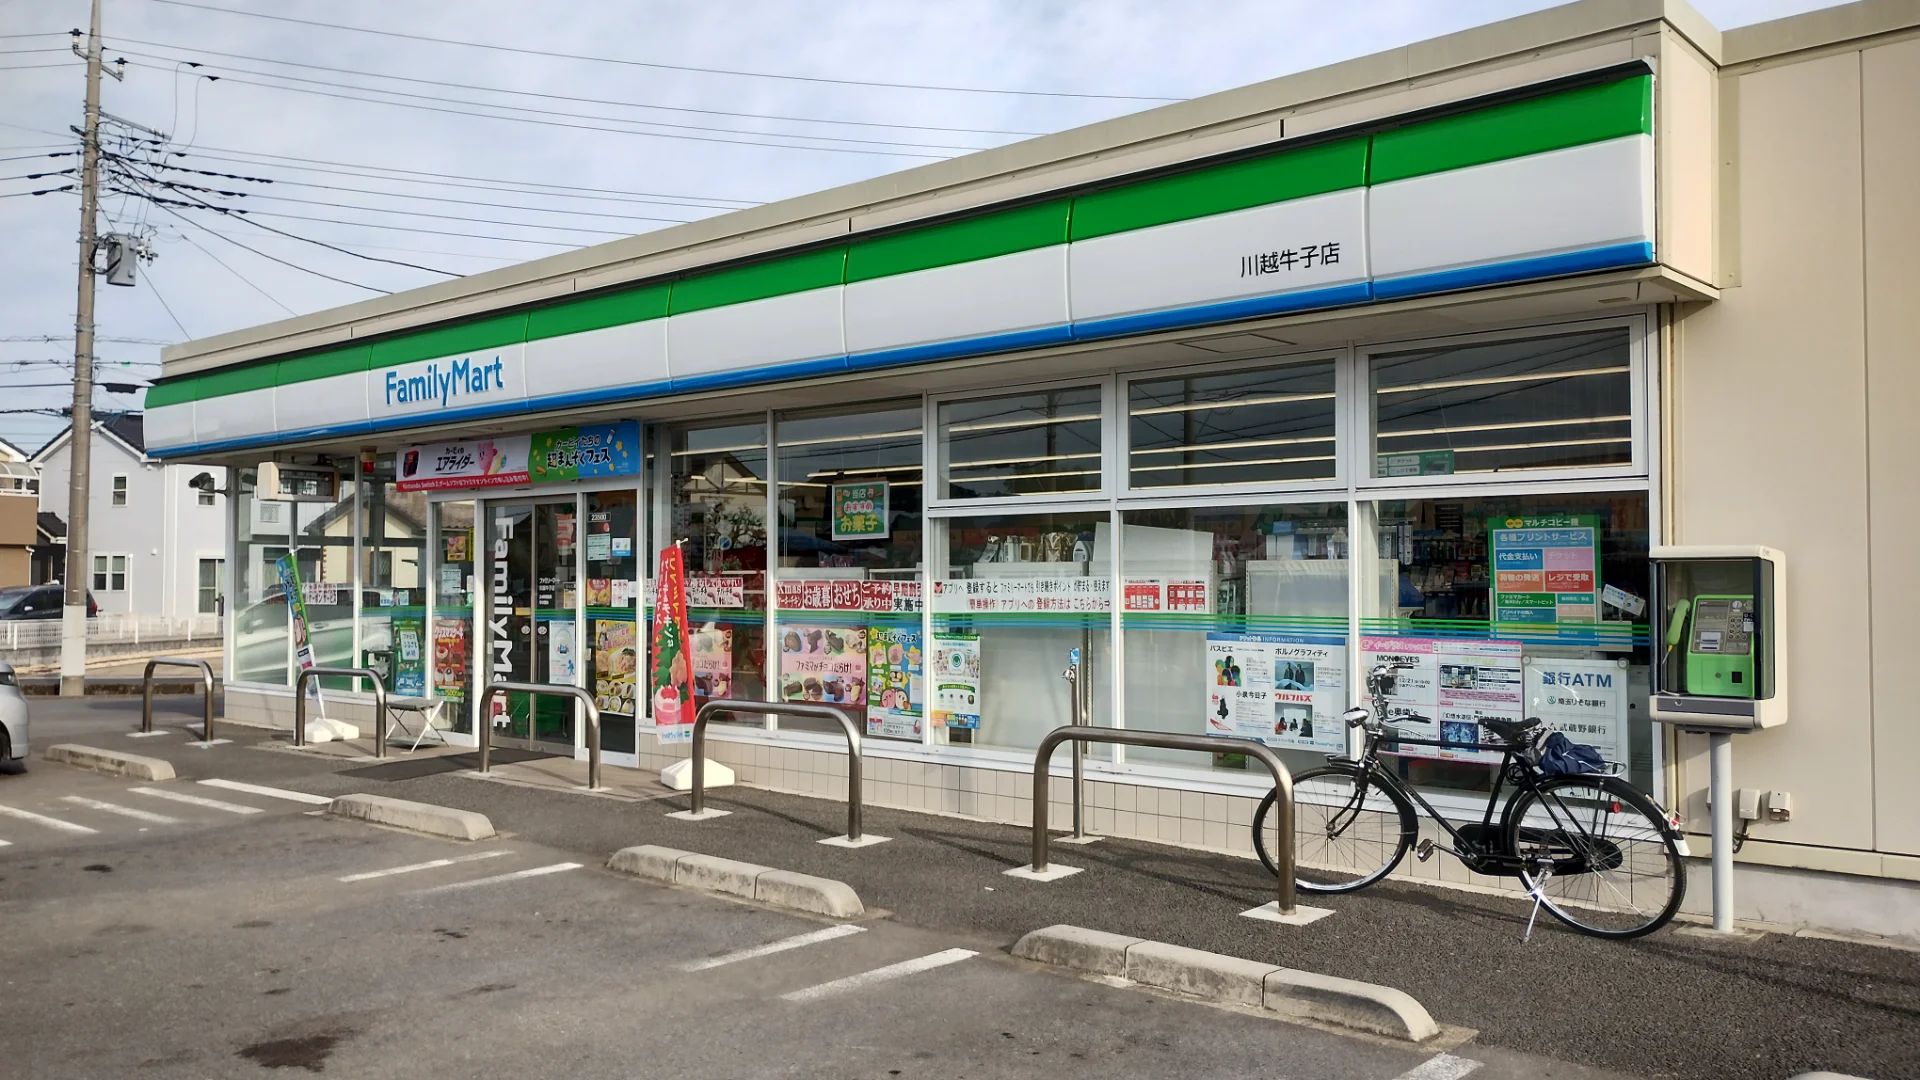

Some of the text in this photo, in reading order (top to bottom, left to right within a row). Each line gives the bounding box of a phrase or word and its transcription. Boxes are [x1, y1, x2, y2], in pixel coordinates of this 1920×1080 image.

[1241, 242, 1340, 278] 川越牛子店
[386, 355, 503, 406] FamilyMart
[435, 454, 475, 472] エアライダー
[547, 448, 610, 468] 超まんぞくフェス
[845, 501, 873, 513] おすすめ
[841, 514, 878, 532] お菓子
[1524, 518, 1579, 527] マルチコピー機
[1500, 532, 1588, 541] 各種プリントサービス
[1499, 552, 1538, 561] 代金支払い
[1548, 552, 1577, 560] チケット
[1548, 573, 1590, 582] レジで受取
[777, 582, 801, 595] Xmas
[861, 583, 892, 595] ご予約
[804, 585, 831, 608] お歳暮
[834, 583, 861, 607] おせち
[862, 598, 892, 610] 承り中
[893, 597, 923, 612] 実施中
[1376, 655, 1420, 663] MONOEYES
[796, 661, 852, 674] ファミマがチョコだらけ!
[1542, 671, 1612, 688] 銀行ATM
[1236, 691, 1267, 699] 小泉今日子
[1275, 693, 1312, 702] ウルフルズ
[1558, 698, 1606, 708] 埼玉りそな銀行
[1559, 722, 1607, 735] 武蔵野銀行
